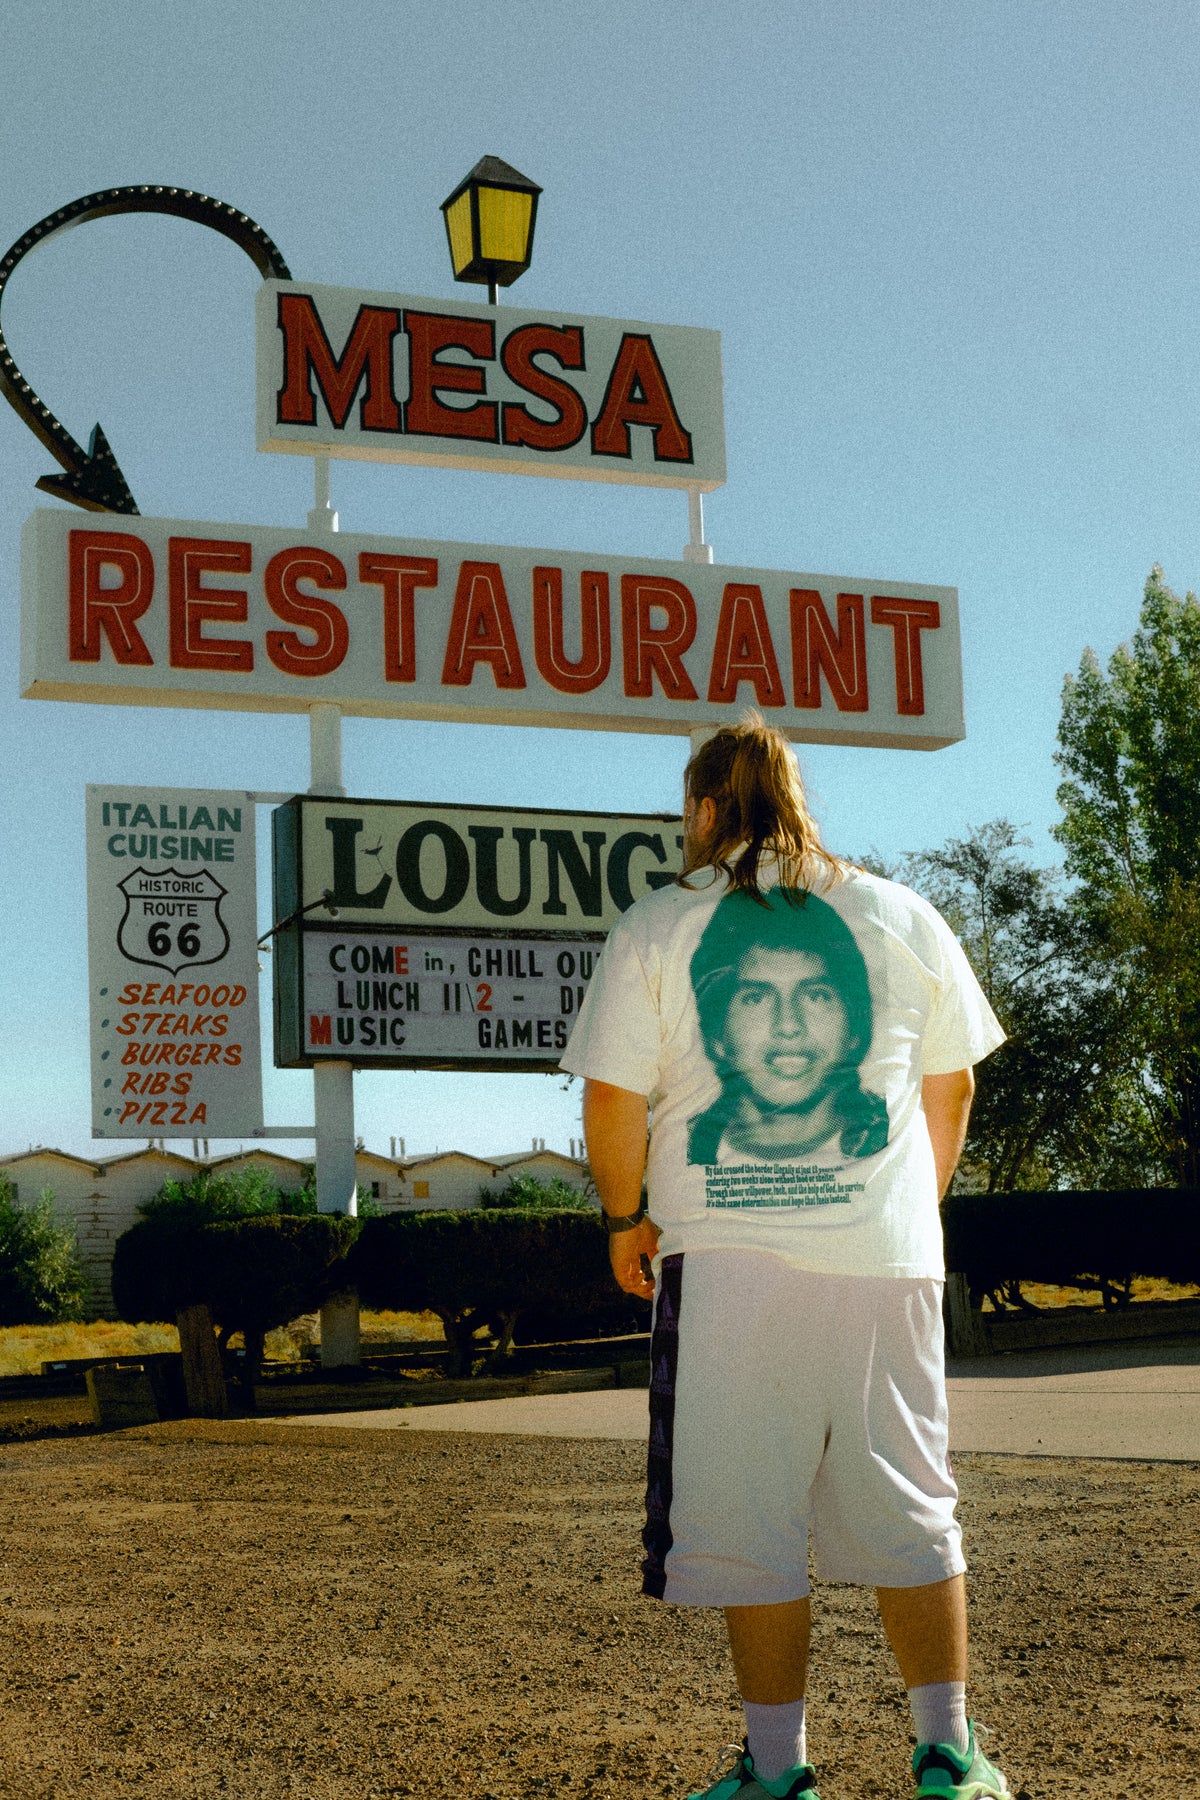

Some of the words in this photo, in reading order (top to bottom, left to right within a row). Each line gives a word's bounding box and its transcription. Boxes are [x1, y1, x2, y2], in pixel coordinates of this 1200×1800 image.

[276, 291, 694, 464] MESA
[67, 529, 941, 717] RESTAURANT
[102, 802, 242, 832] ITALIAN
[107, 833, 235, 862] CUISINE
[325, 817, 683, 917] LOUNG
[139, 880, 204, 893] HISTORIC
[143, 902, 198, 917] ROUTE
[148, 921, 201, 958] 66
[329, 944, 409, 974] COME
[468, 947, 543, 978] CHILL
[557, 951, 600, 980] OU
[117, 983, 247, 1008] SEAFOOD
[338, 981, 419, 1011] LUNCH
[115, 1013, 229, 1036] STEAKS
[310, 1016, 405, 1045] MUSIC
[478, 1018, 567, 1049] GAMES
[120, 1042, 242, 1066] BURGERS
[121, 1072, 193, 1095] RIBS
[119, 1101, 207, 1125] PIZZA
